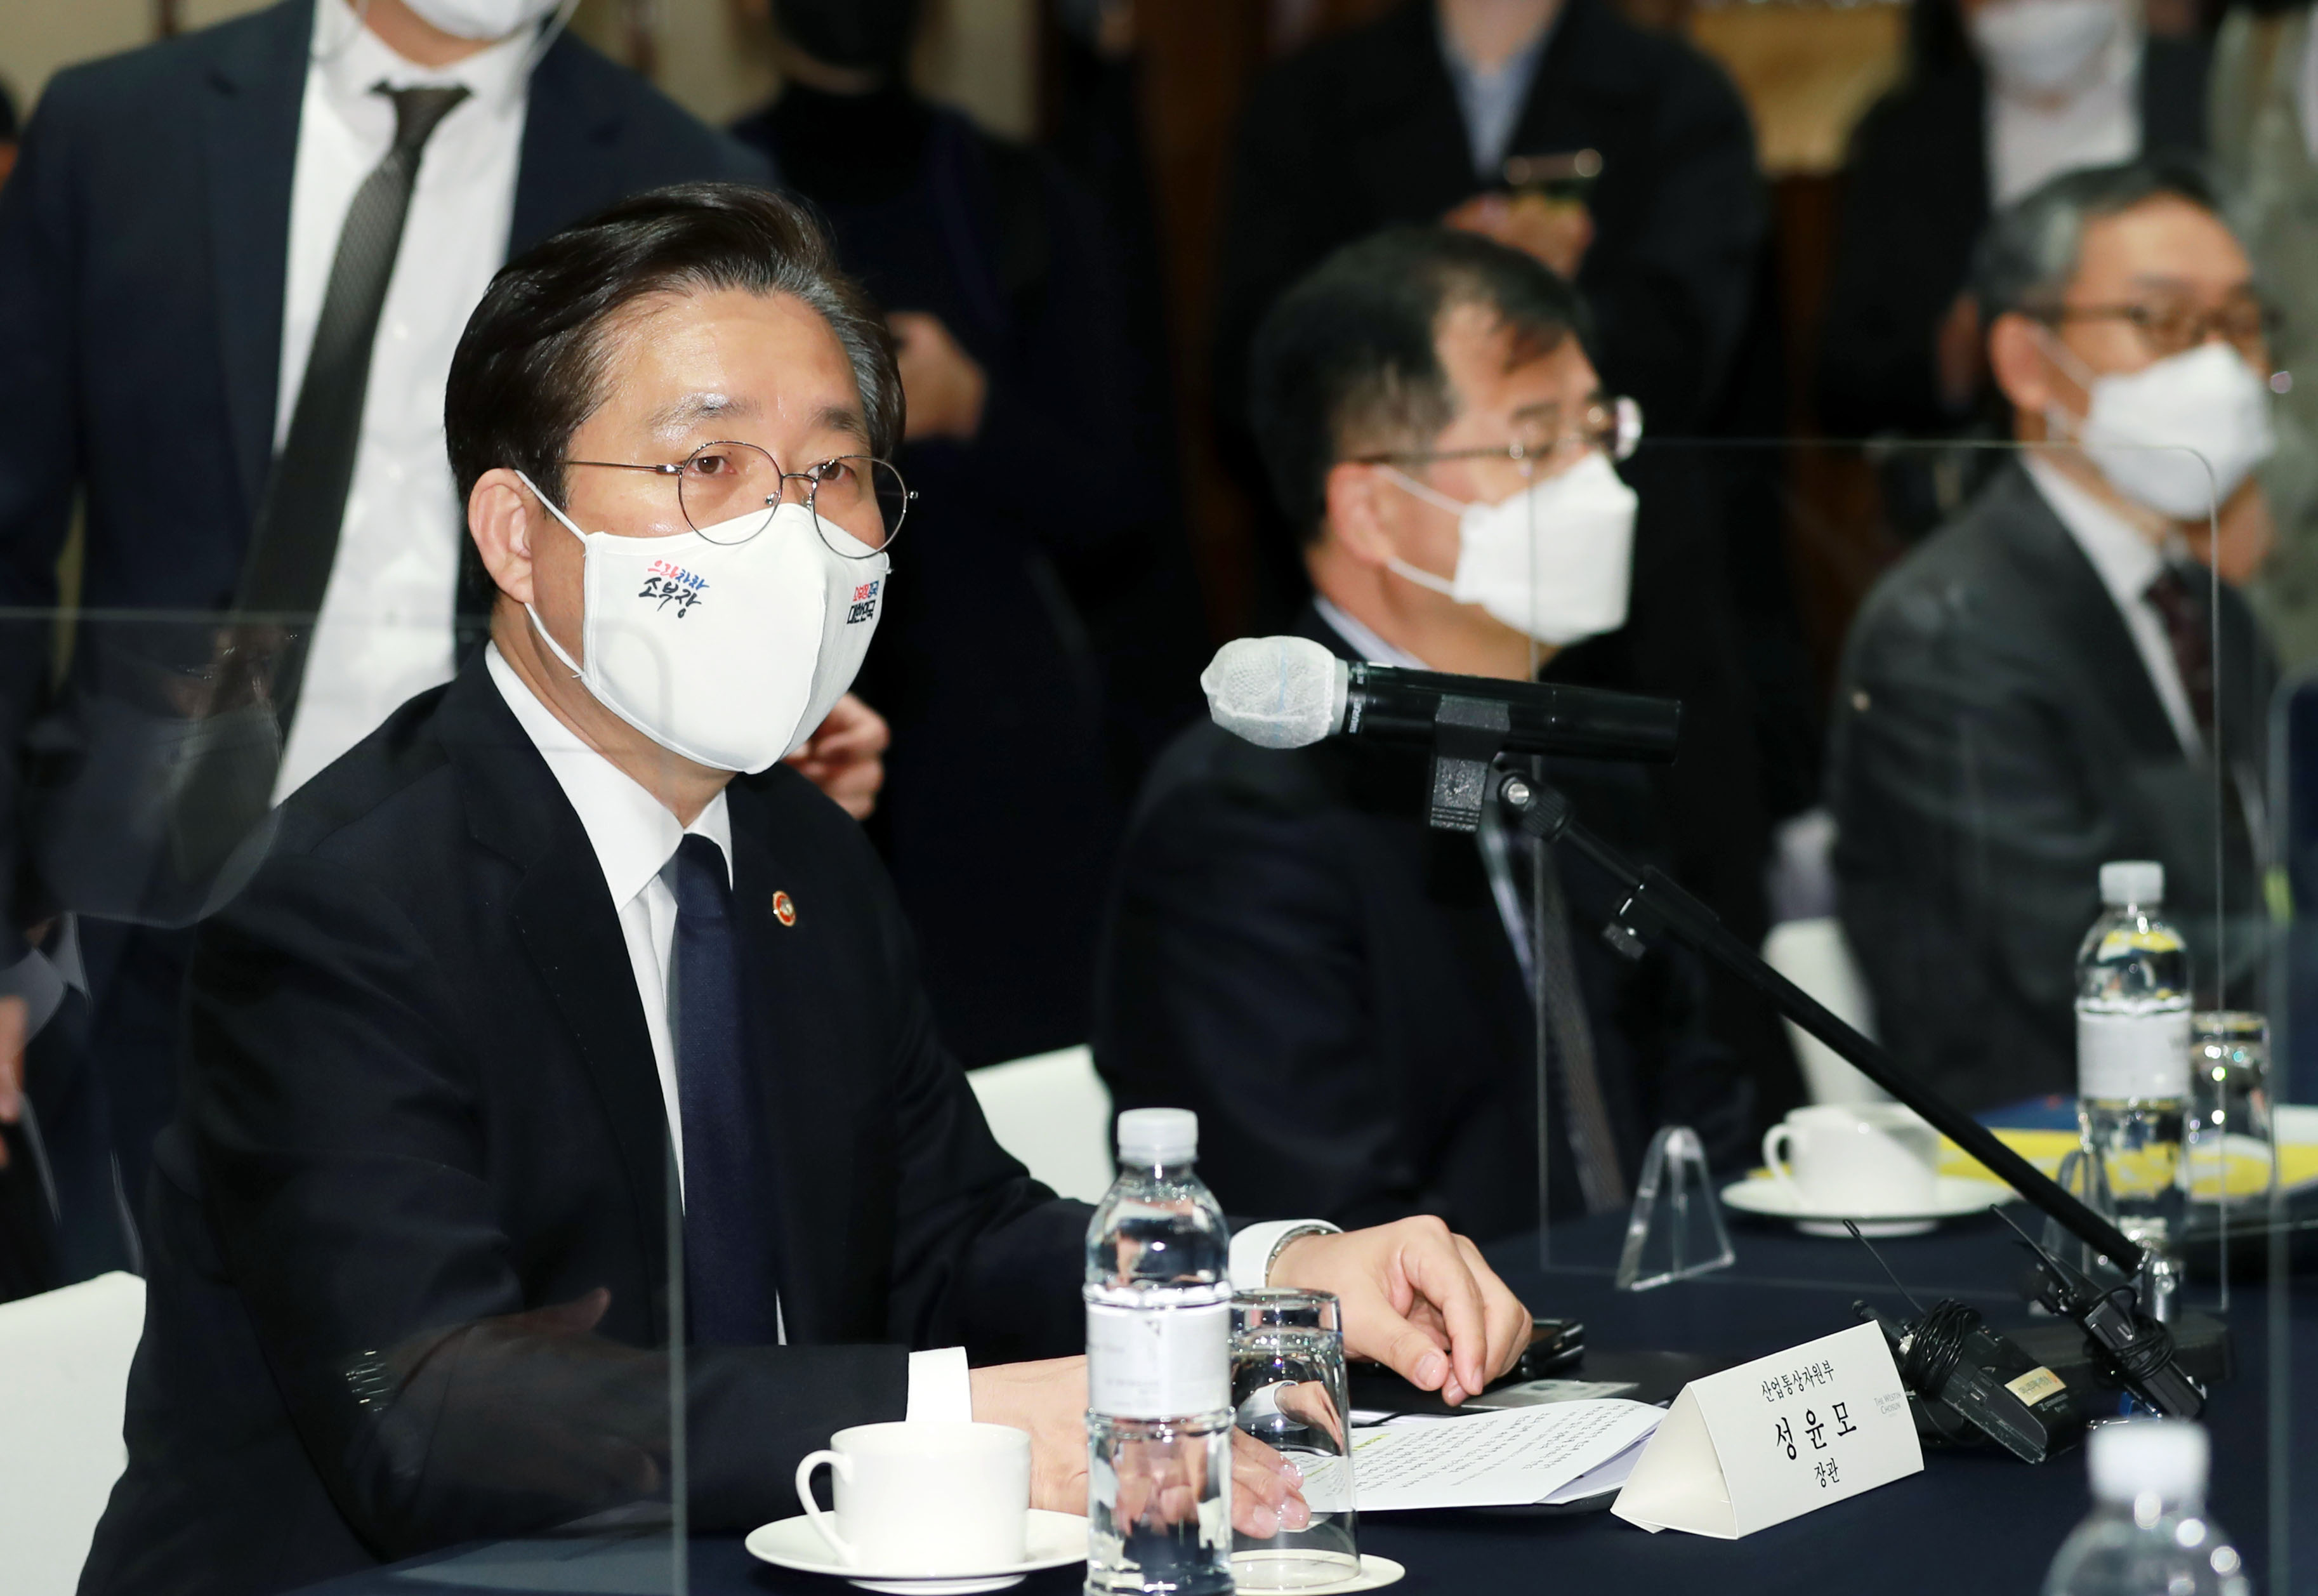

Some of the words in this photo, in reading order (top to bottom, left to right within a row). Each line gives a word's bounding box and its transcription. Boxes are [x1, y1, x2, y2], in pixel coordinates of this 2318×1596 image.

[638, 577, 702, 618] 소부장
[1761, 1360, 1834, 1402] 산업통상자원부
[1814, 1458, 1840, 1487] 장관
